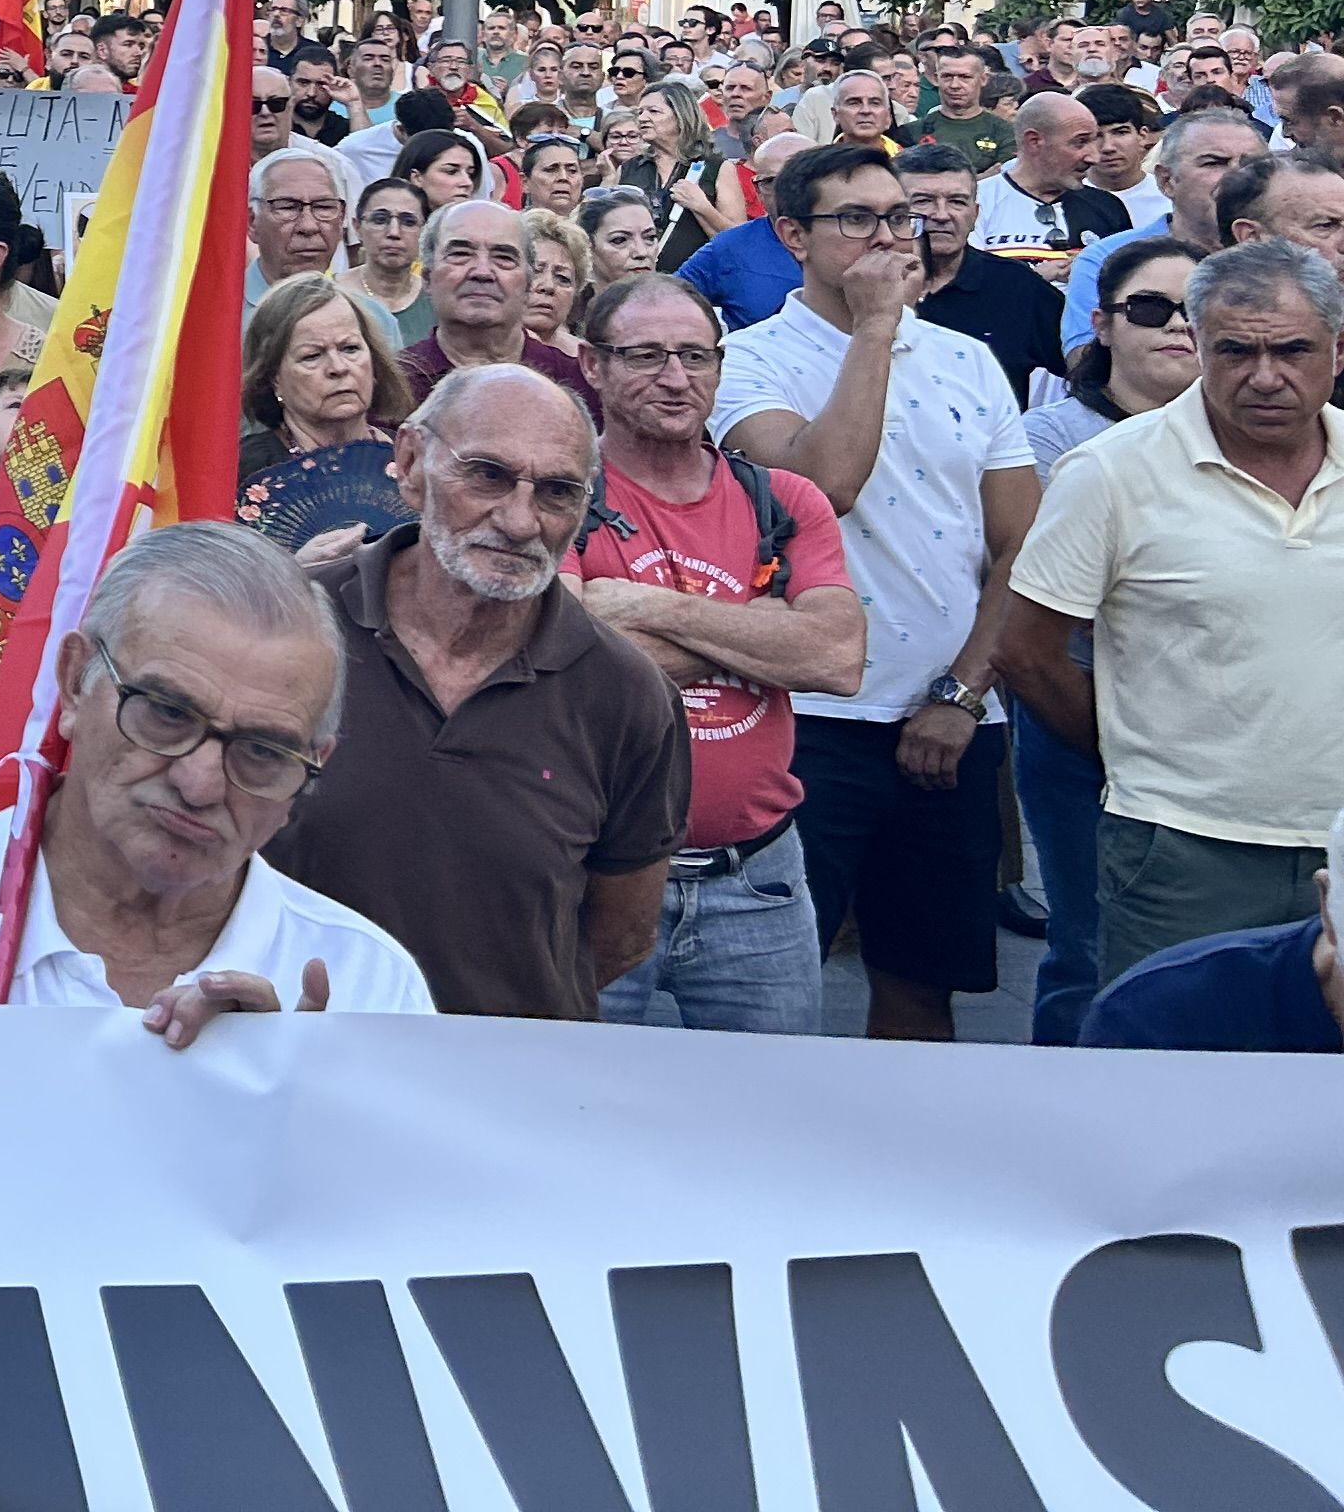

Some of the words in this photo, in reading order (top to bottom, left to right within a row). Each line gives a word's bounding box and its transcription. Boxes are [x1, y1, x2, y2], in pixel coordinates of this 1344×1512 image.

[985, 234, 1051, 245] CEUT
[705, 564, 744, 594] DESIGN
[697, 726, 733, 741] DENIM
